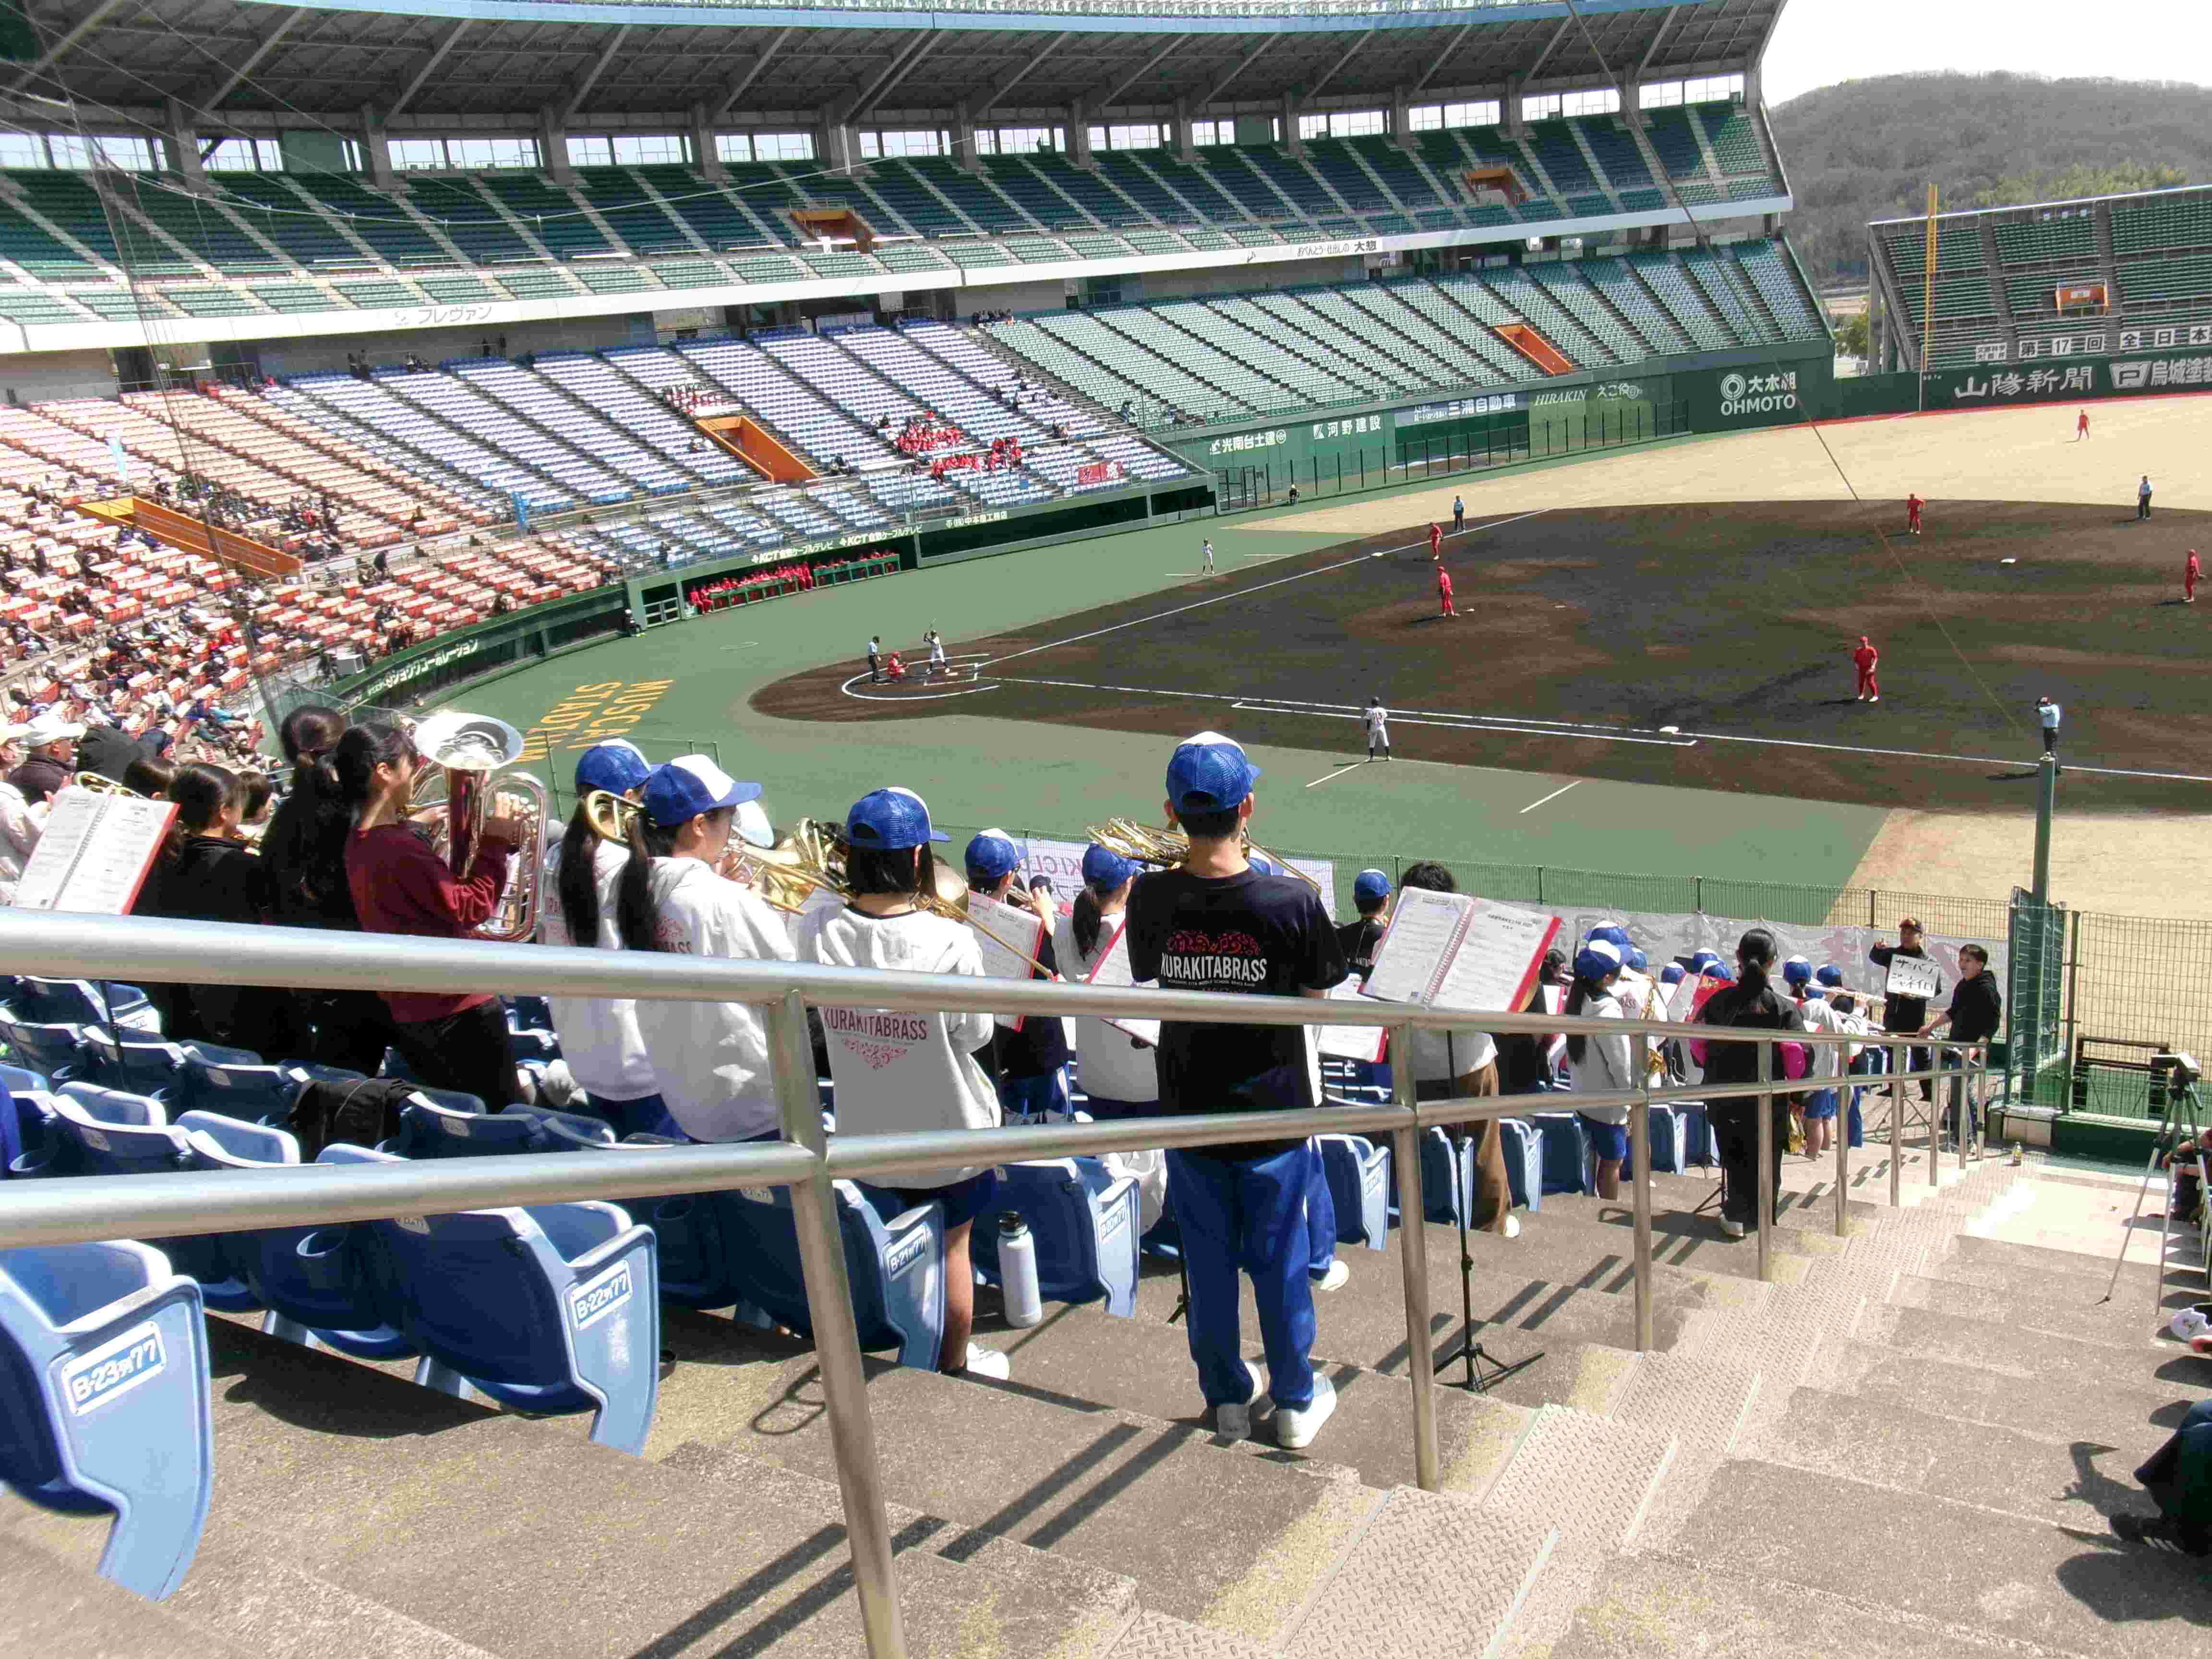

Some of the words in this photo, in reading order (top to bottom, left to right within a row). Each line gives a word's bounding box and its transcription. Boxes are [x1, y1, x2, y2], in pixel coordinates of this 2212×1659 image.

[1748, 372, 1796, 393] 大本組
[1955, 366, 2093, 398] 山陽新聞
[1448, 394, 1516, 415] 三浦自動車
[1534, 388, 1588, 407] HIRAKIN
[1721, 394, 1795, 416] OHMOTO
[1327, 415, 1382, 437] 河野建設
[846, 534, 867, 546] KCT
[759, 548, 779, 563] KCT
[824, 1007, 929, 1040] KURAKITABRASS
